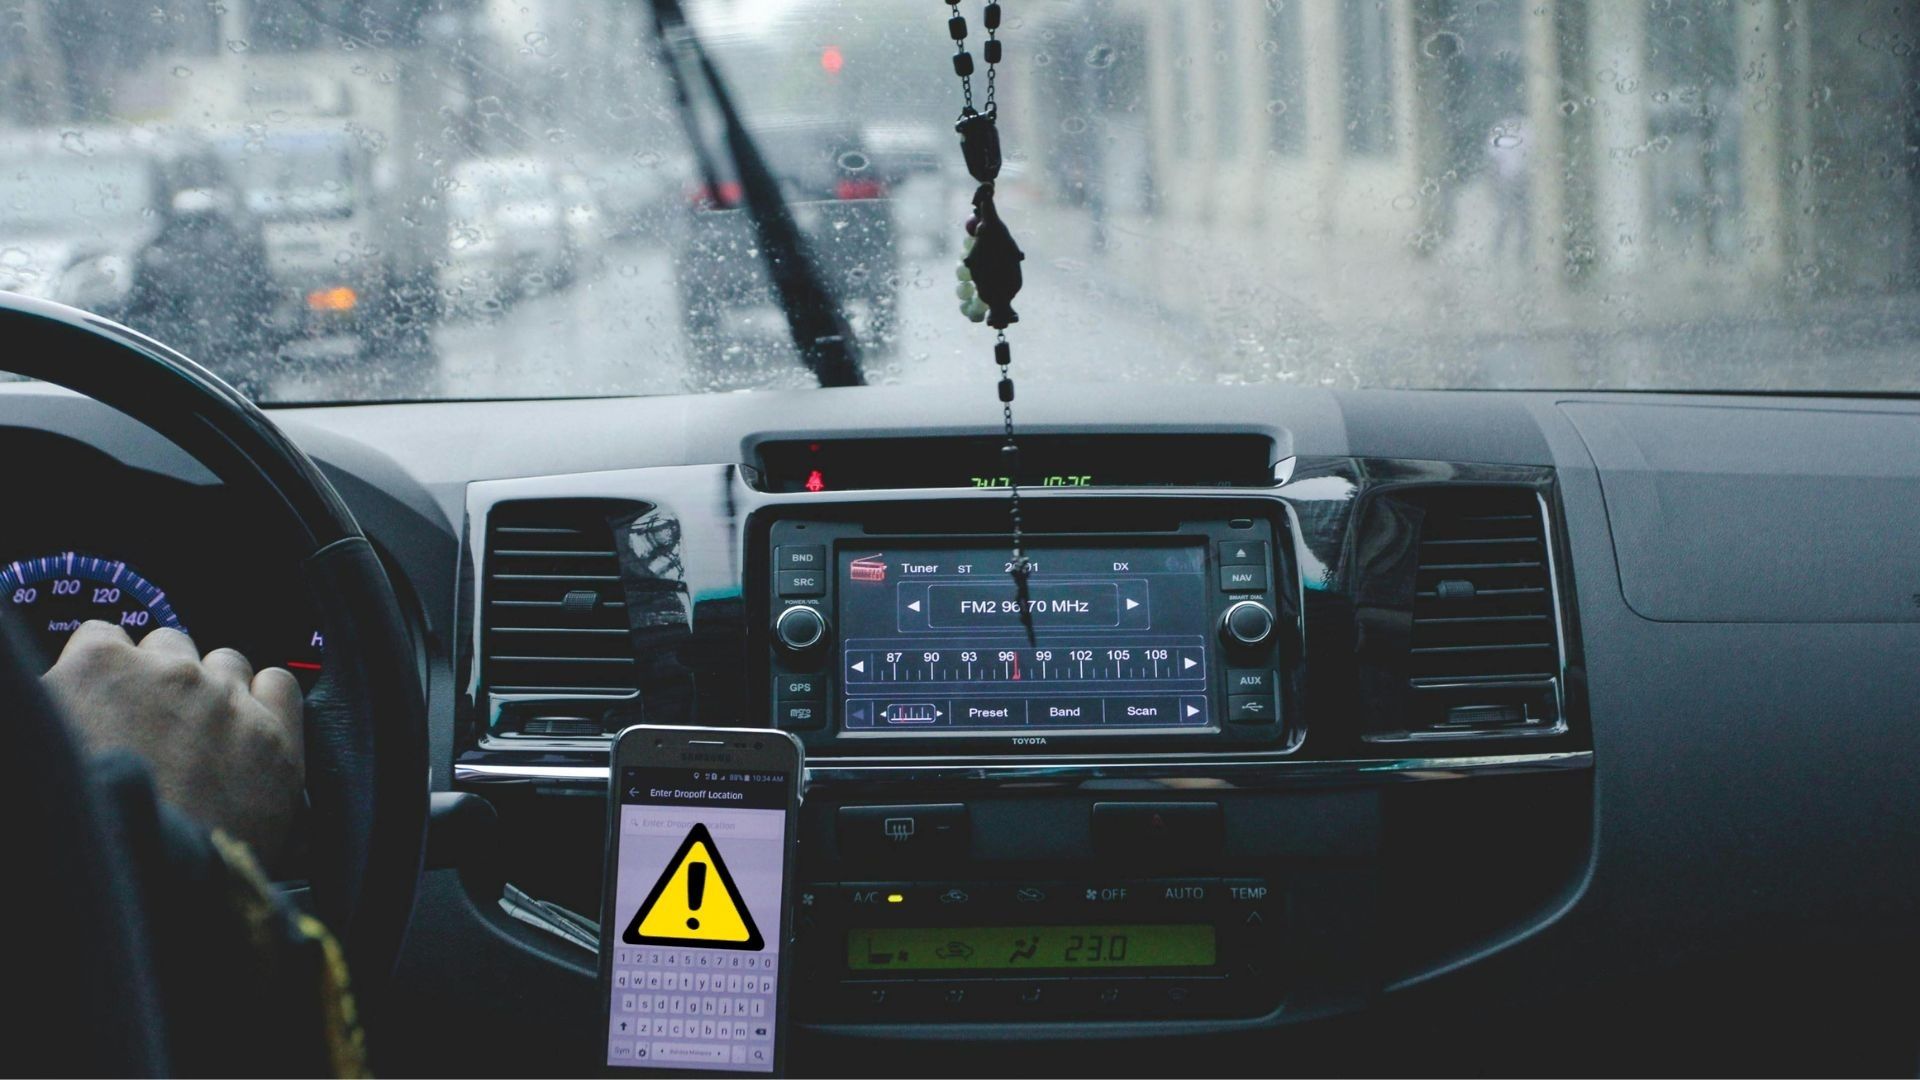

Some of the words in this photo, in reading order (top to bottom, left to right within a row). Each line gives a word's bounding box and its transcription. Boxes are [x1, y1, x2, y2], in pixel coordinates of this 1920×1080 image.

[792, 554, 813, 562] BND
[901, 563, 938, 573] Tuner
[958, 565, 972, 573] ST
[1113, 562, 1129, 571] DX
[793, 578, 815, 586] SRC
[1232, 574, 1252, 582] NAV
[52, 580, 81, 595] 100
[13, 588, 37, 603] 80
[92, 588, 121, 603] 120
[961, 601, 996, 613] FM2
[1001, 600, 1047, 613] 9670
[1052, 600, 1089, 612] MHz
[120, 611, 149, 626] 140
[886, 652, 902, 662] 87
[924, 652, 940, 662] 90
[961, 652, 977, 662] 93
[998, 651, 1015, 661] 96
[1035, 651, 1052, 661] 99
[1069, 651, 1092, 661] 102
[1107, 650, 1130, 660] 105
[1144, 650, 1168, 660] 108
[1240, 676, 1261, 685] AUX
[789, 684, 811, 692] GPS
[969, 708, 1008, 718] Preset
[1050, 707, 1081, 717] Band
[1127, 706, 1157, 716] Scan
[1012, 737, 1047, 745] TOYOTA
[650, 788, 672, 797] Enter
[674, 790, 706, 801] Dropoff
[708, 790, 743, 800] Location
[854, 891, 879, 904] A/C
[1101, 888, 1127, 900] OFF
[1165, 887, 1204, 899] AUTO
[1230, 887, 1267, 899] TEMP
[1064, 935, 1129, 962] 23.0
